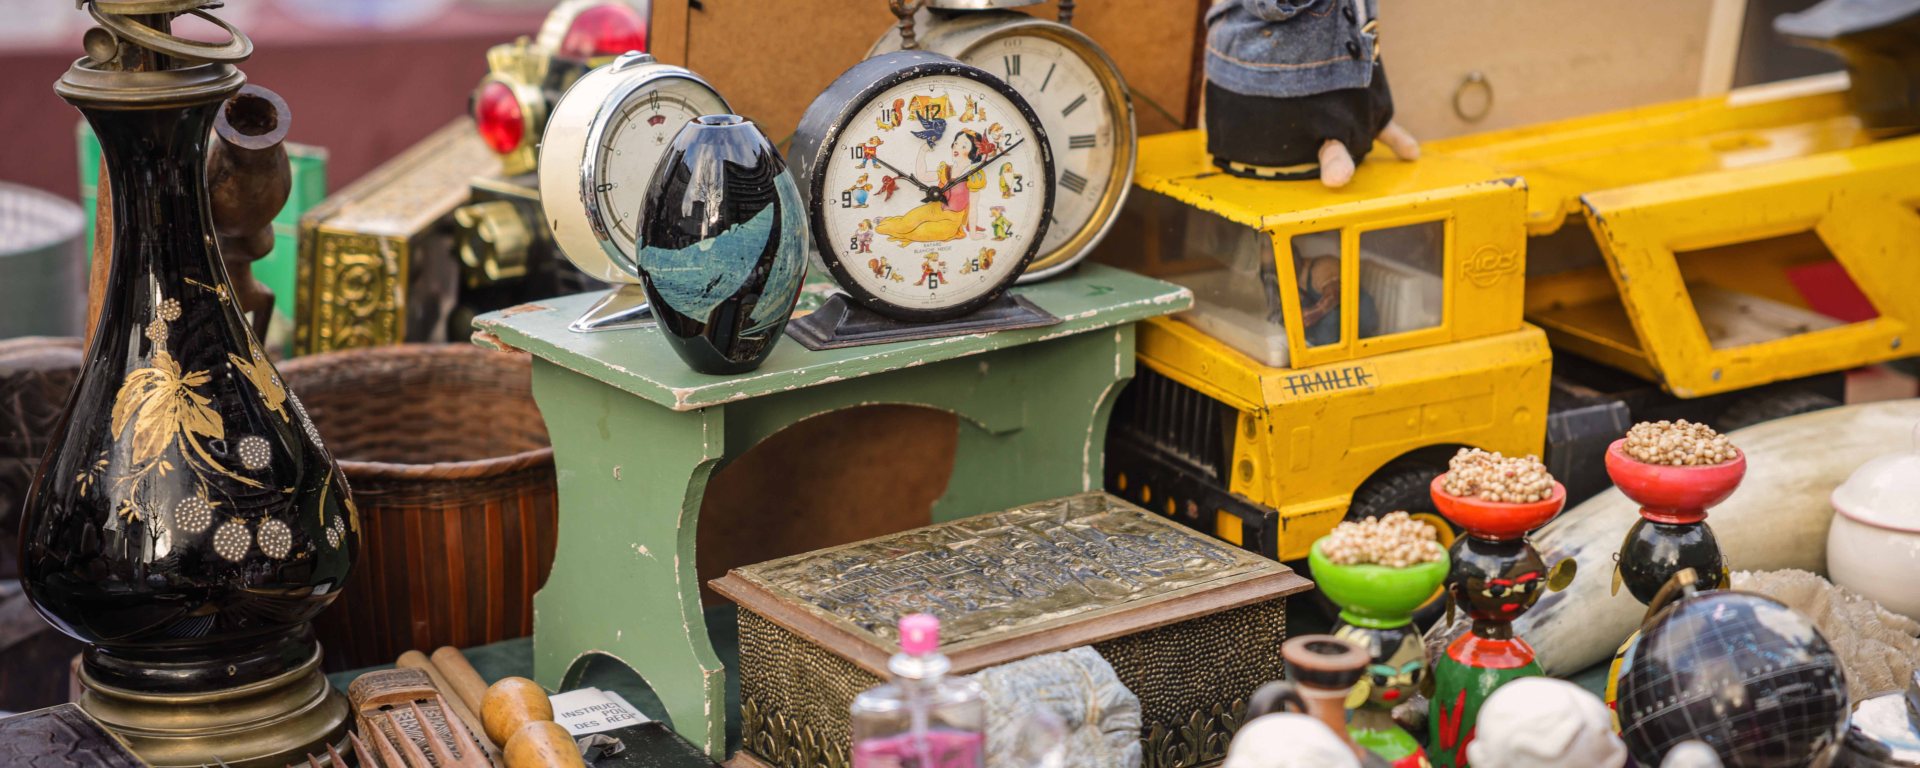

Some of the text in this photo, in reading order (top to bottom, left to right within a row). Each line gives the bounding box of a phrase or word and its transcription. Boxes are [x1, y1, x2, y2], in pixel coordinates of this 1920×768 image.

[925, 103, 941, 120] 12
[973, 101, 978, 115] 1
[1061, 93, 1088, 118] II
[881, 108, 890, 122] 11
[1004, 133, 1012, 146] 2
[1068, 134, 1096, 149] III
[850, 146, 863, 160] 10
[1013, 175, 1023, 193] 3
[842, 191, 852, 209] 9
[1005, 224, 1014, 237] 4
[850, 237, 858, 250] 8
[971, 258, 979, 272] 5
[884, 266, 892, 280] 7
[928, 272, 938, 289] 6
[1282, 366, 1373, 396] TRAILER
[574, 720, 600, 730] DES
